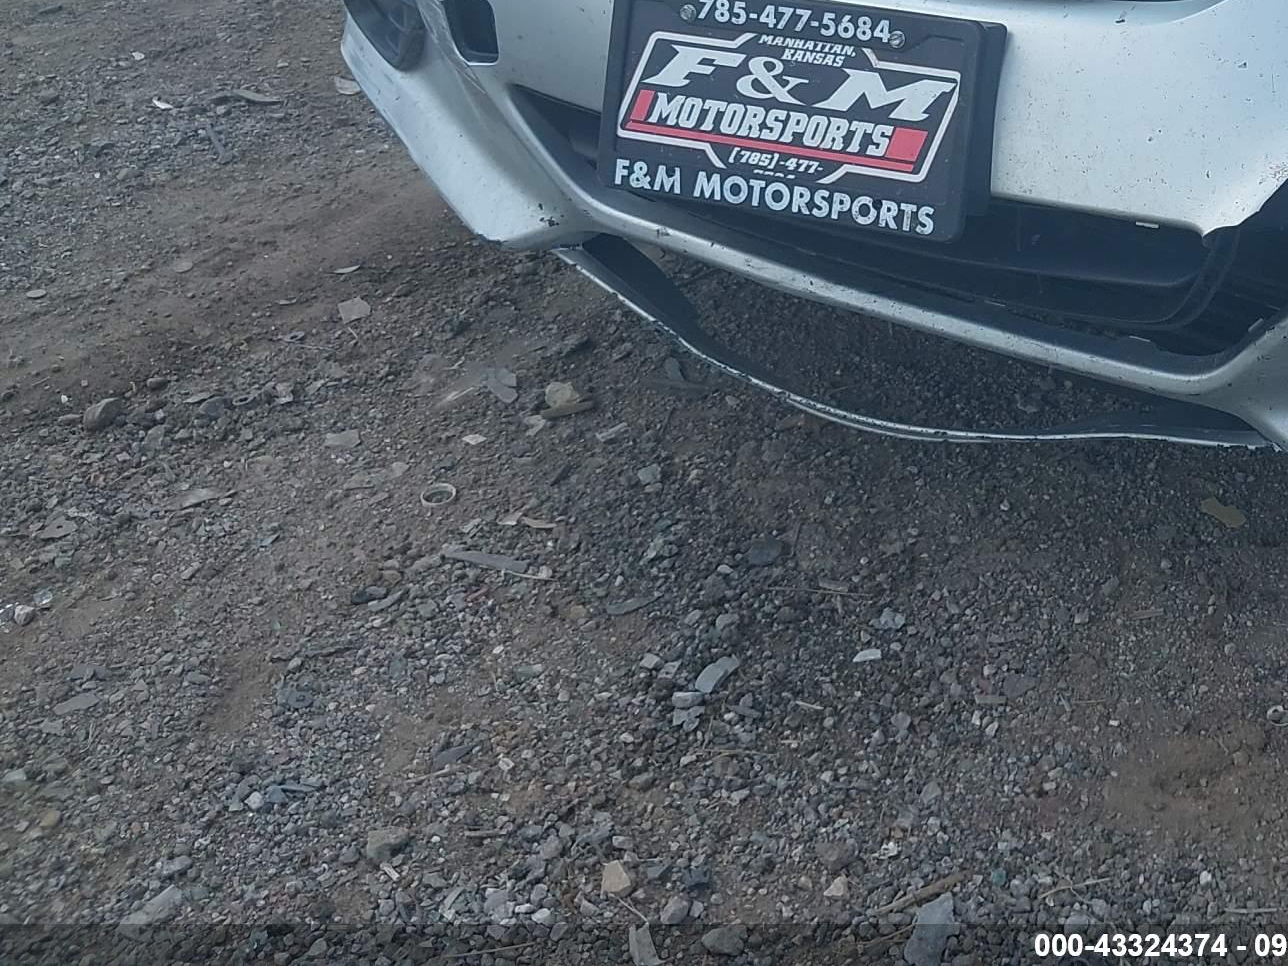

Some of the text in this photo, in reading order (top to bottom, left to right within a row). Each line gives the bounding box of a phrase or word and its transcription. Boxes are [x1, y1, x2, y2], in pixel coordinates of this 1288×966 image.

[758, 34, 857, 57] MANHATTAN,
[780, 48, 846, 68] KANSAS
[647, 90, 896, 157] MOTORSPORTS
[613, 158, 936, 236] F&M MOTORSPORTS
